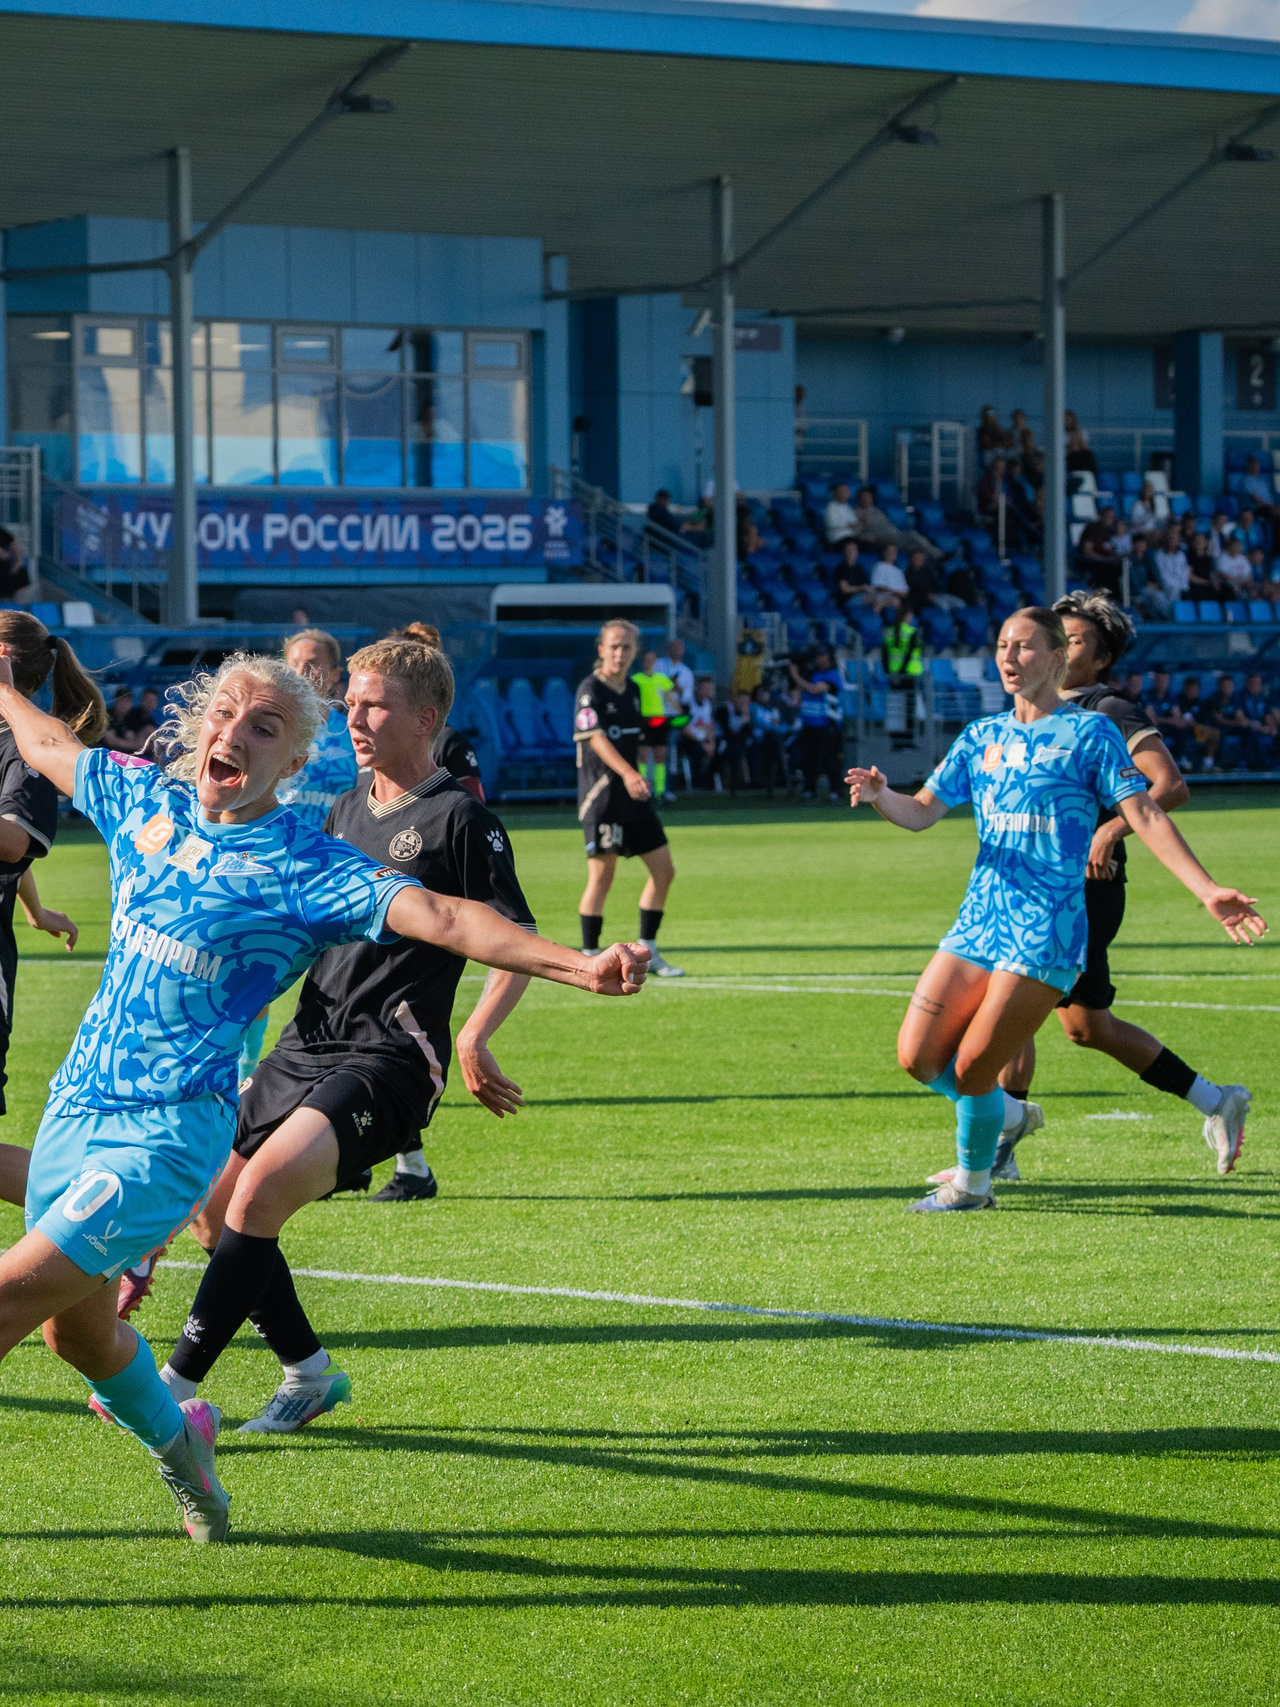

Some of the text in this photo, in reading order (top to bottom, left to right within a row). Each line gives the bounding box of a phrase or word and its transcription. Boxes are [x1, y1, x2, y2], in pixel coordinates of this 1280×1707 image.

[1249, 354, 1265, 387] 2
[122, 511, 252, 551] КУОК
[263, 513, 420, 551] РОССИИ
[431, 513, 534, 551] 2026
[146, 821, 172, 844] G
[123, 915, 223, 983] ГАЗПРОМ
[82, 1233, 108, 1257] JÖGEL
